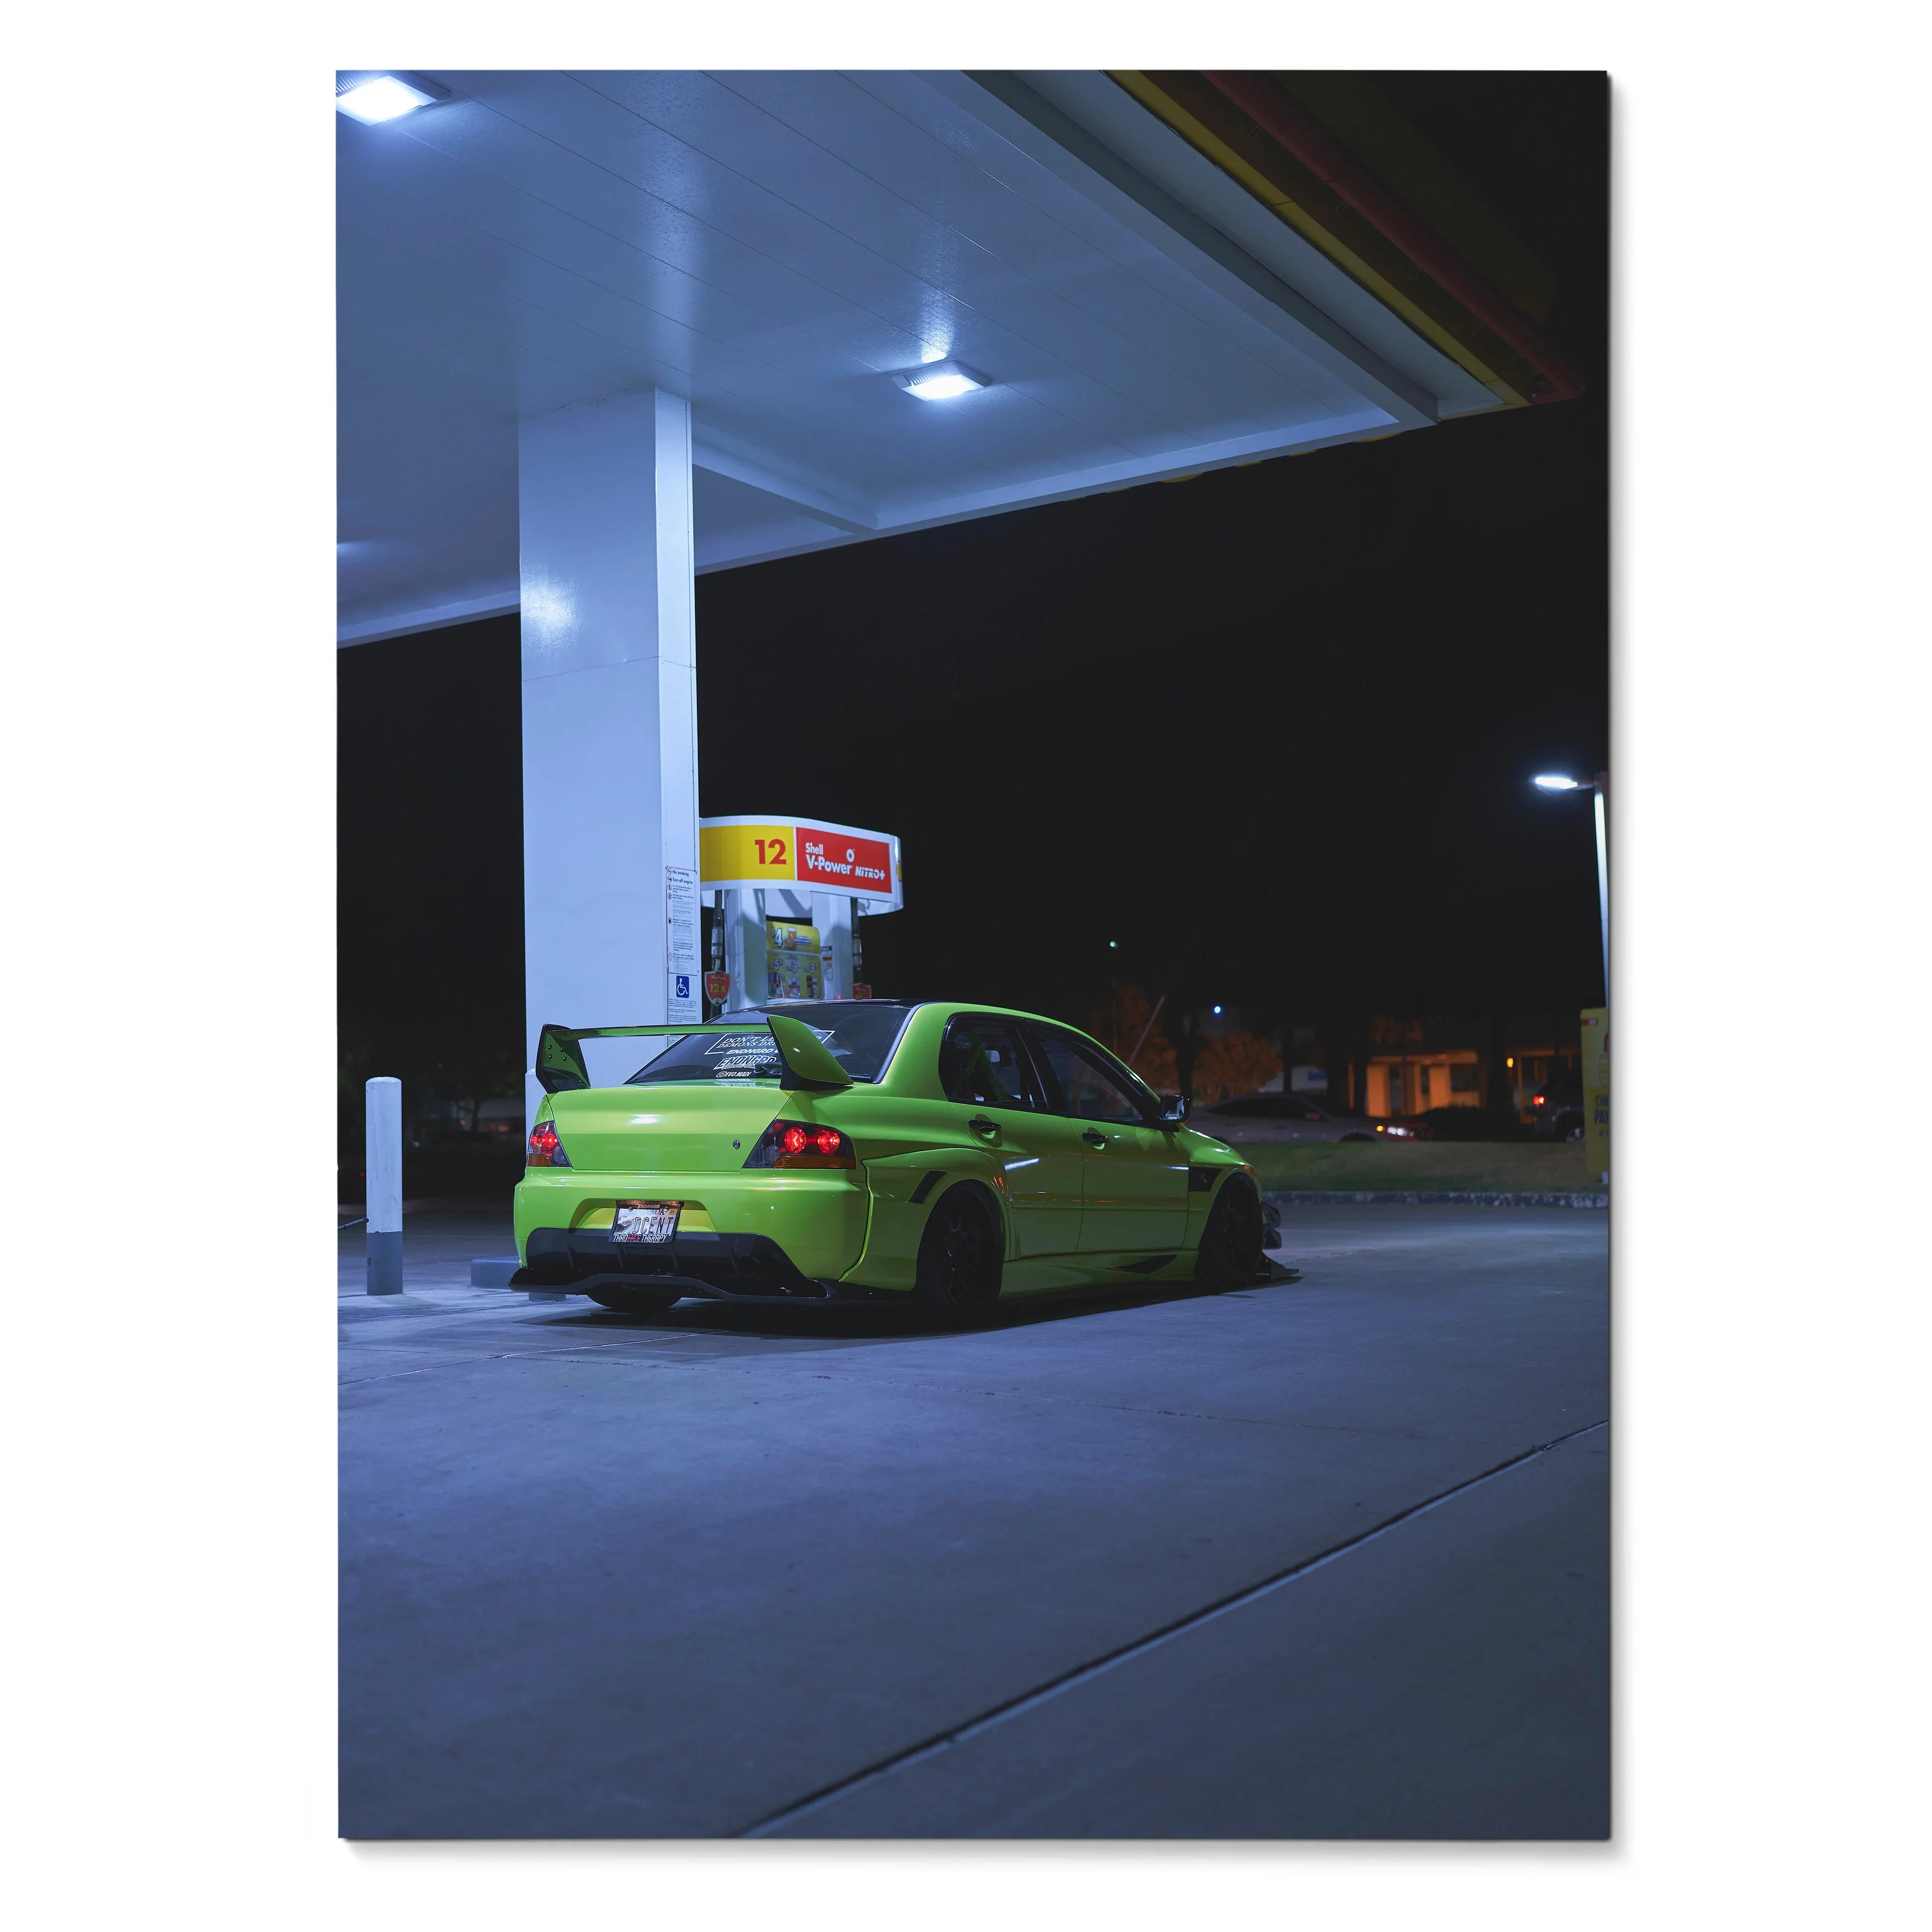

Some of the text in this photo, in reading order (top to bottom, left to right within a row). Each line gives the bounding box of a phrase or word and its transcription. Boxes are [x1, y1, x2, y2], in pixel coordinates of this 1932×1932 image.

[754, 838, 787, 865] 12
[805, 842, 824, 855] Shell
[806, 854, 852, 875] V-Power
[632, 1217, 674, 1234] DCENT
[641, 1234, 668, 1242] THERAPY
